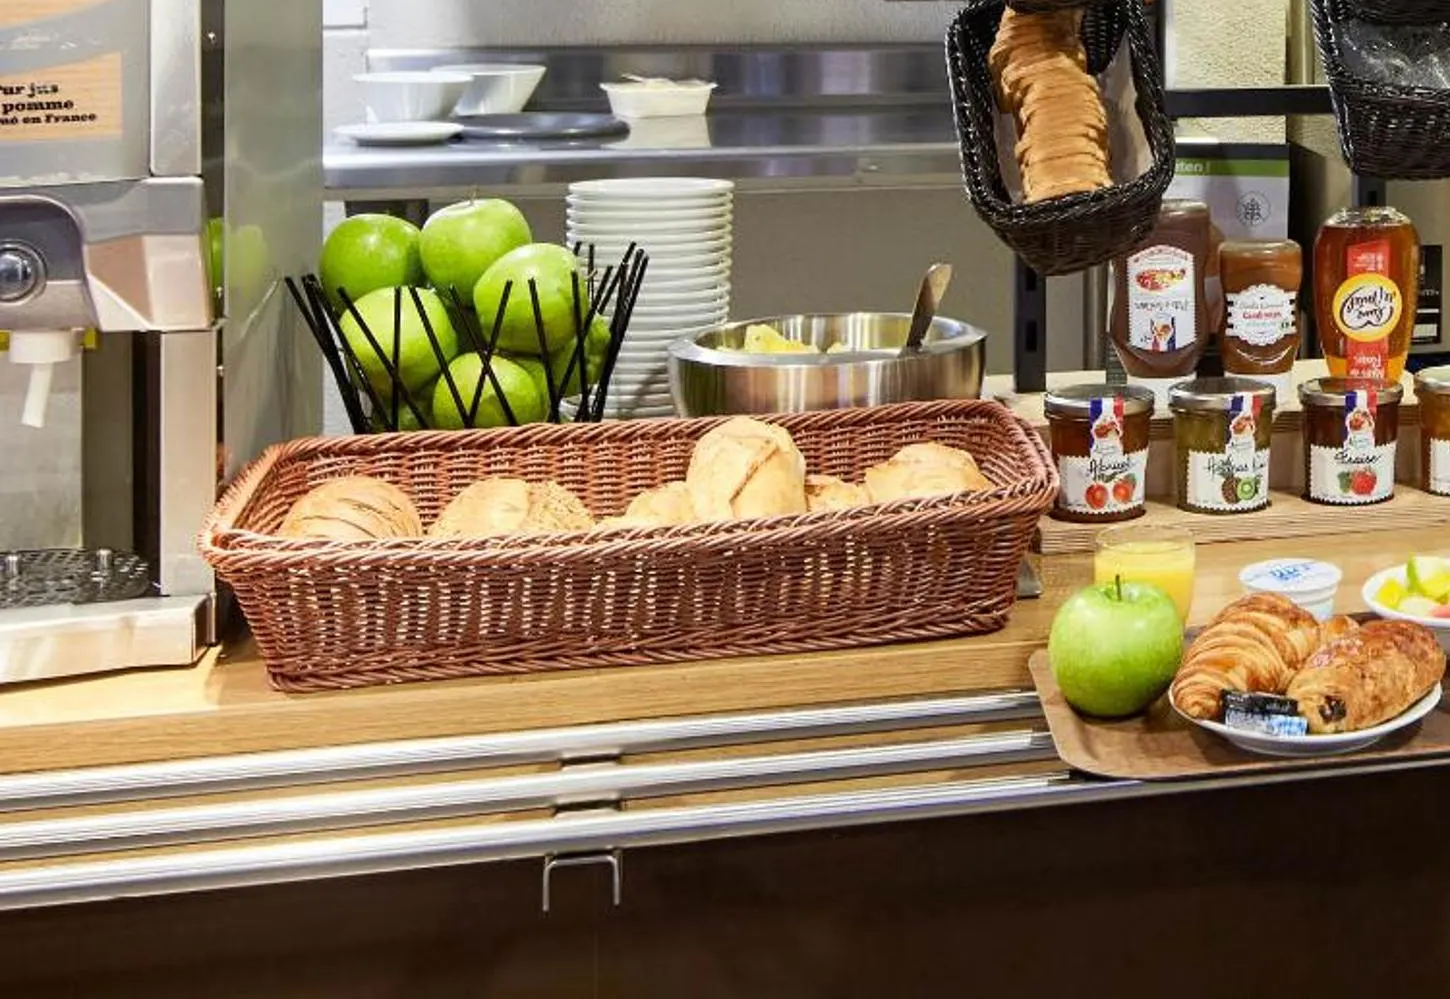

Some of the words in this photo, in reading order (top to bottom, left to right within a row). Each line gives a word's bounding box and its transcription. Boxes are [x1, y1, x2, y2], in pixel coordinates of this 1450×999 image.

[2, 100, 74, 115] pomme
[22, 116, 42, 124] en
[45, 113, 96, 123] France
